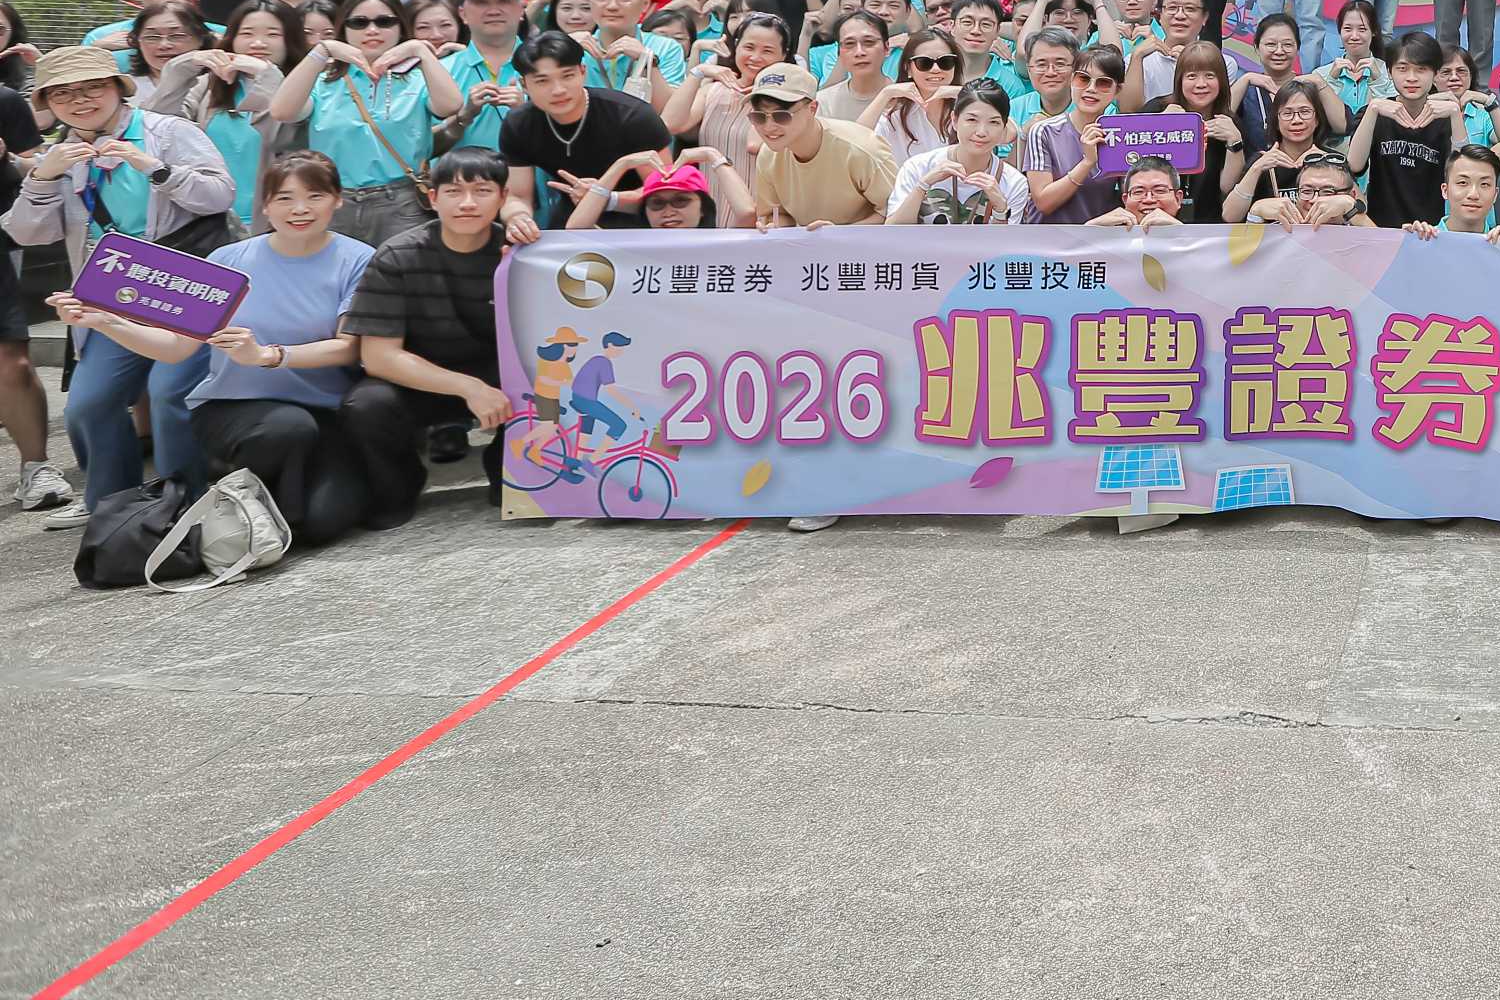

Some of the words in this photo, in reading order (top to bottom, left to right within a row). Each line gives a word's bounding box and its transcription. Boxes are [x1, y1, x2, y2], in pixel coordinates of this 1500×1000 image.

[1103, 127, 1195, 147] 不怕莫名威脅
[95, 247, 232, 306] 不聽投資明牌
[631, 264, 774, 295] 兆豐證券
[801, 262, 941, 292] 兆豐期貨
[967, 260, 1108, 291] 兆豐投顧
[661, 350, 886, 444] 2026
